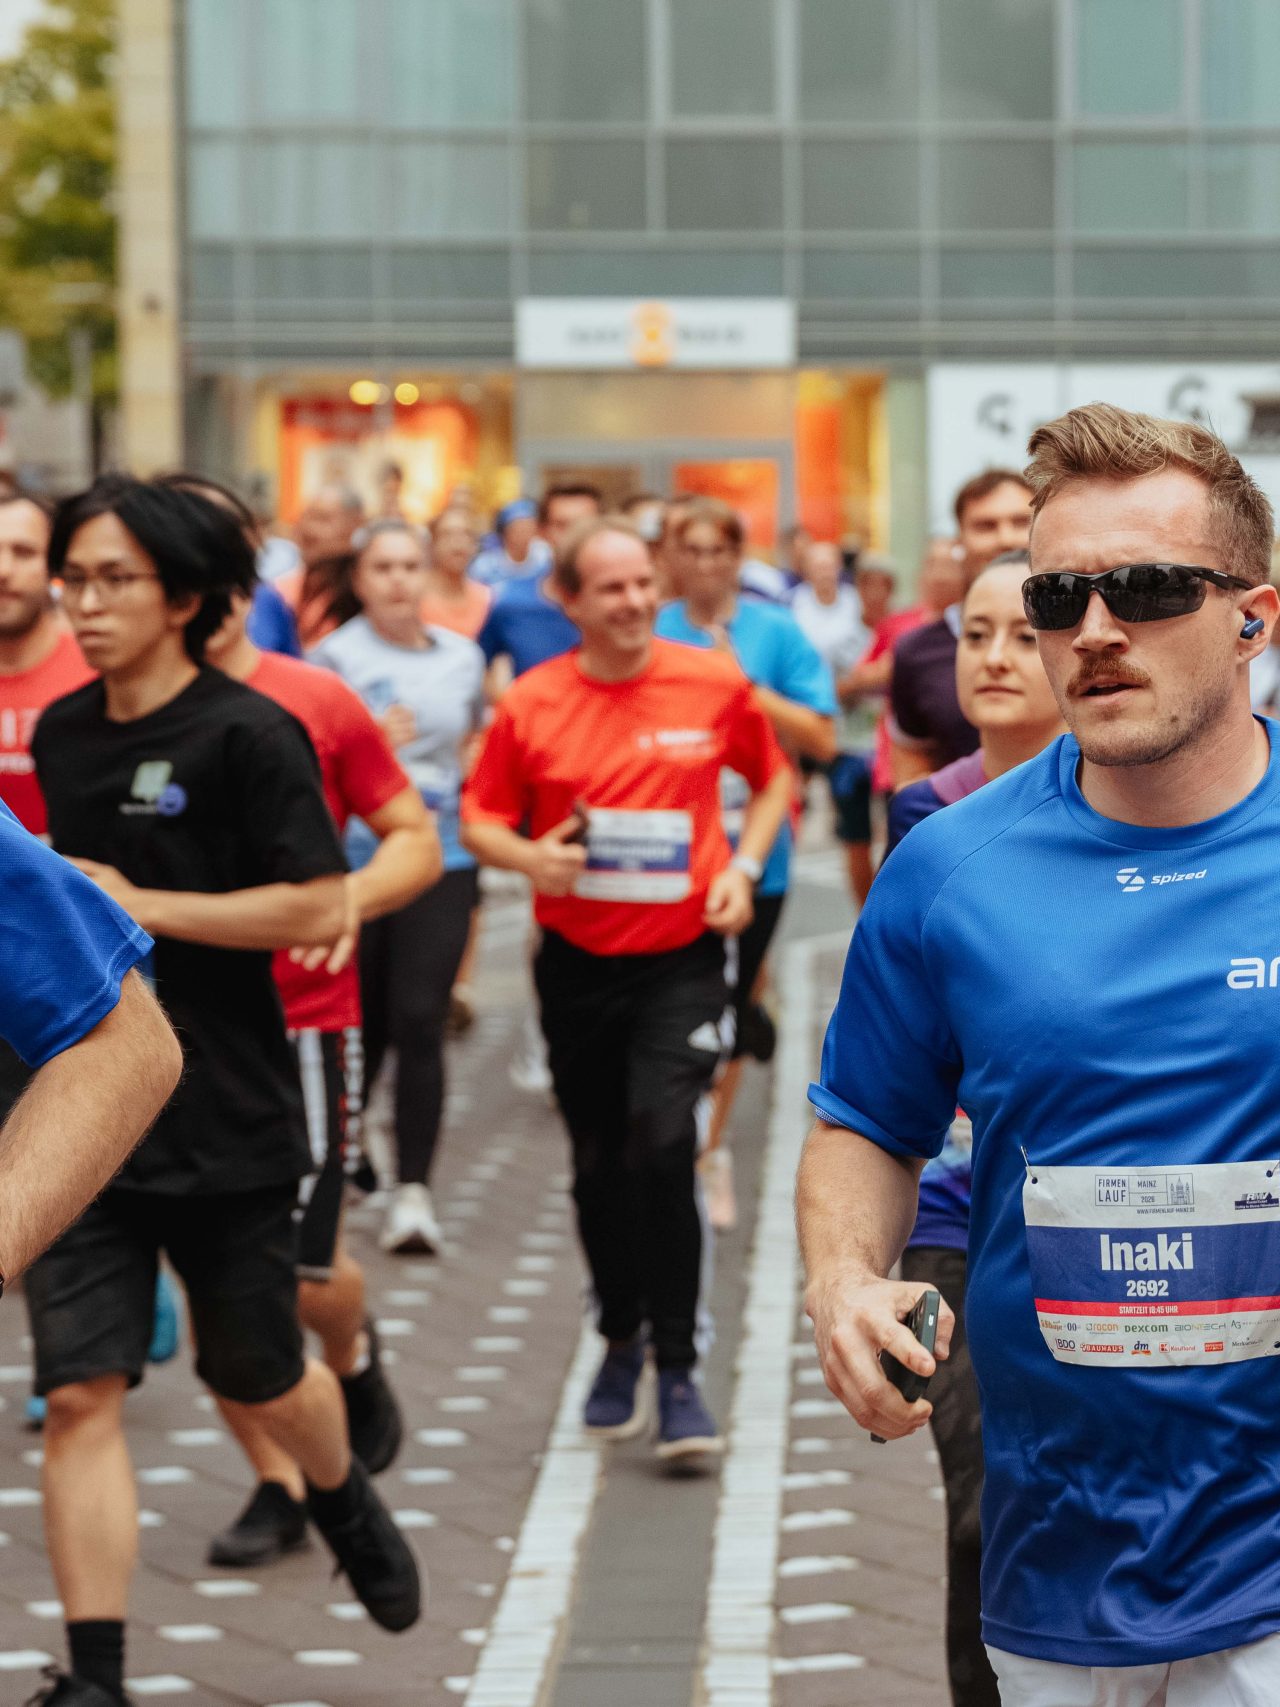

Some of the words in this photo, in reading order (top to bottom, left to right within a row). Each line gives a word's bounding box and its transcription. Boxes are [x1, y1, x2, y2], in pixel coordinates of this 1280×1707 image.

[1151, 869, 1207, 885] spized
[1098, 1178, 1126, 1188] FIRMEN
[1137, 1180, 1157, 1188] MAINZ
[1098, 1189, 1126, 1202] LAUF
[1100, 1232, 1194, 1271] Inaki
[1126, 1279, 1169, 1297] 2692
[1119, 1305, 1148, 1314] STARTZEIT
[1149, 1305, 1165, 1314] 18:45
[1165, 1305, 1178, 1313] UHR
[1057, 1338, 1076, 1350] BDO
[1087, 1344, 1123, 1352] BAUHAUS
[1133, 1340, 1149, 1350] dm
